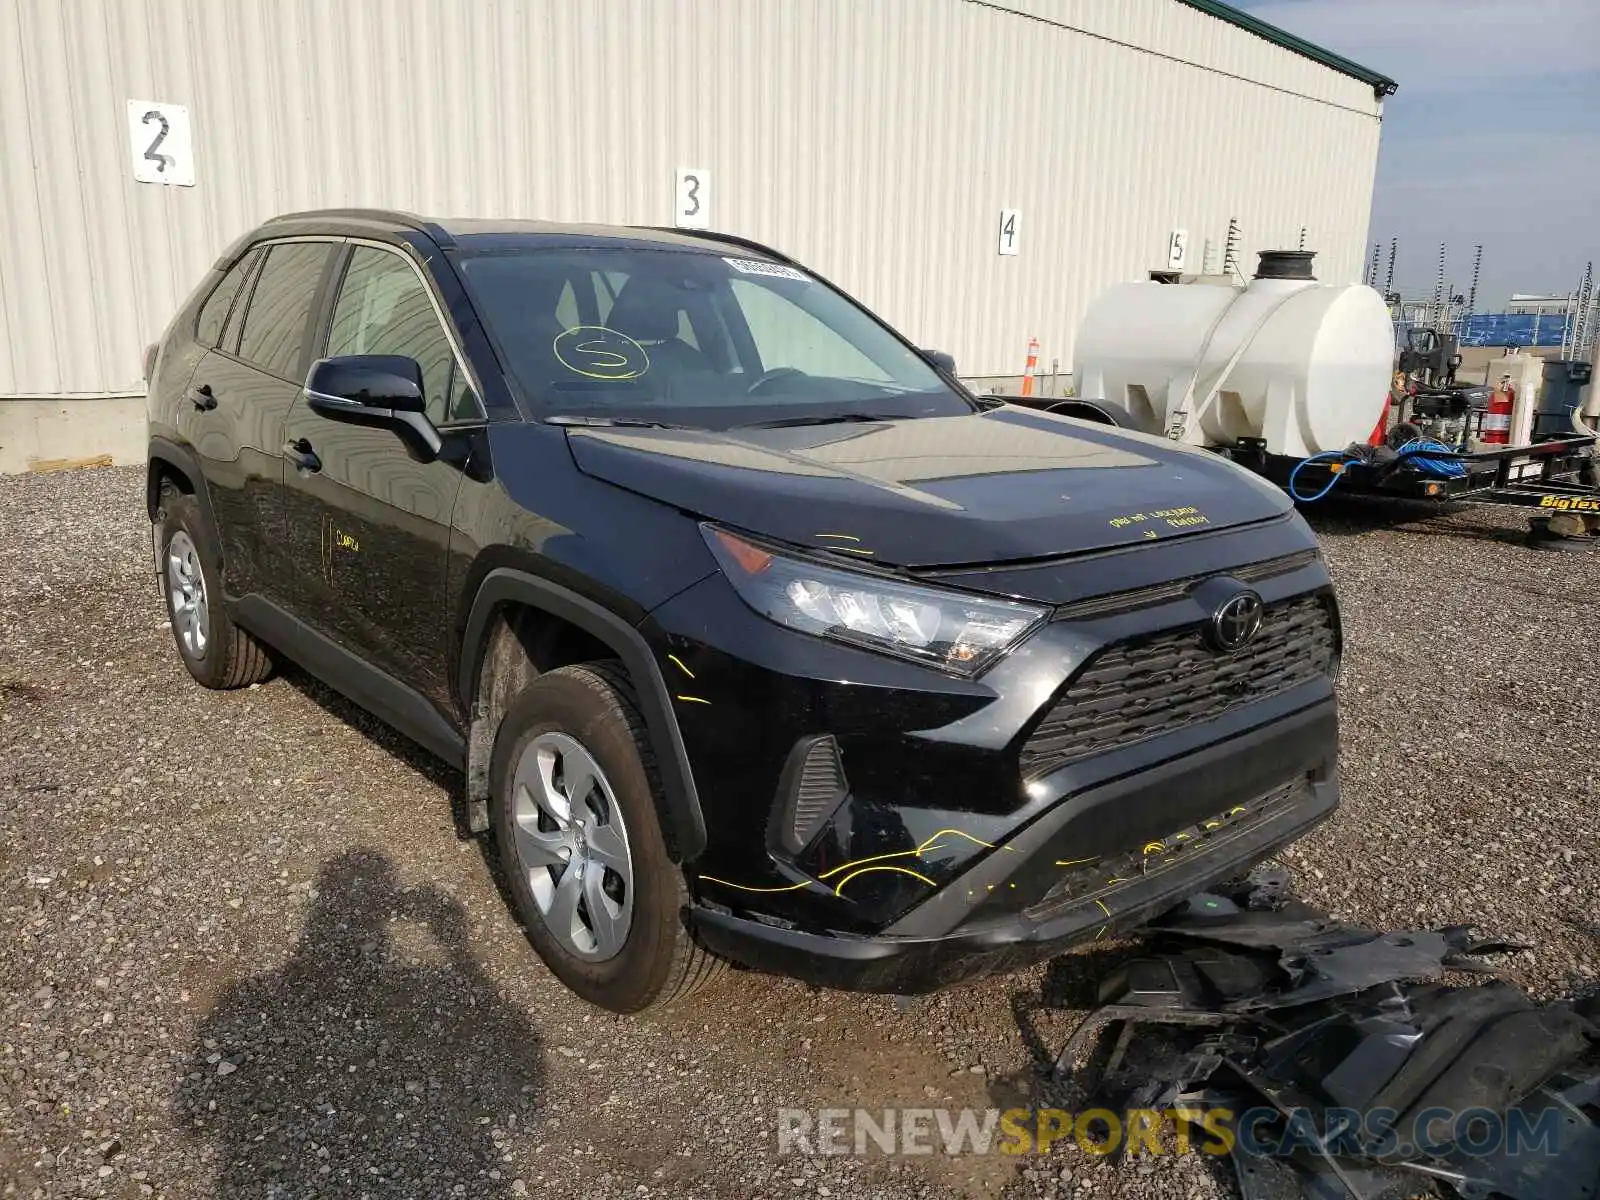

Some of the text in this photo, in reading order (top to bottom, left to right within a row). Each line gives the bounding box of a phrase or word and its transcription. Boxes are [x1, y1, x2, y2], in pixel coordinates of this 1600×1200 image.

[142, 110, 176, 173] 2
[684, 175, 700, 216] 3
[1003, 213, 1015, 248] 4
[1173, 233, 1184, 261] 5
